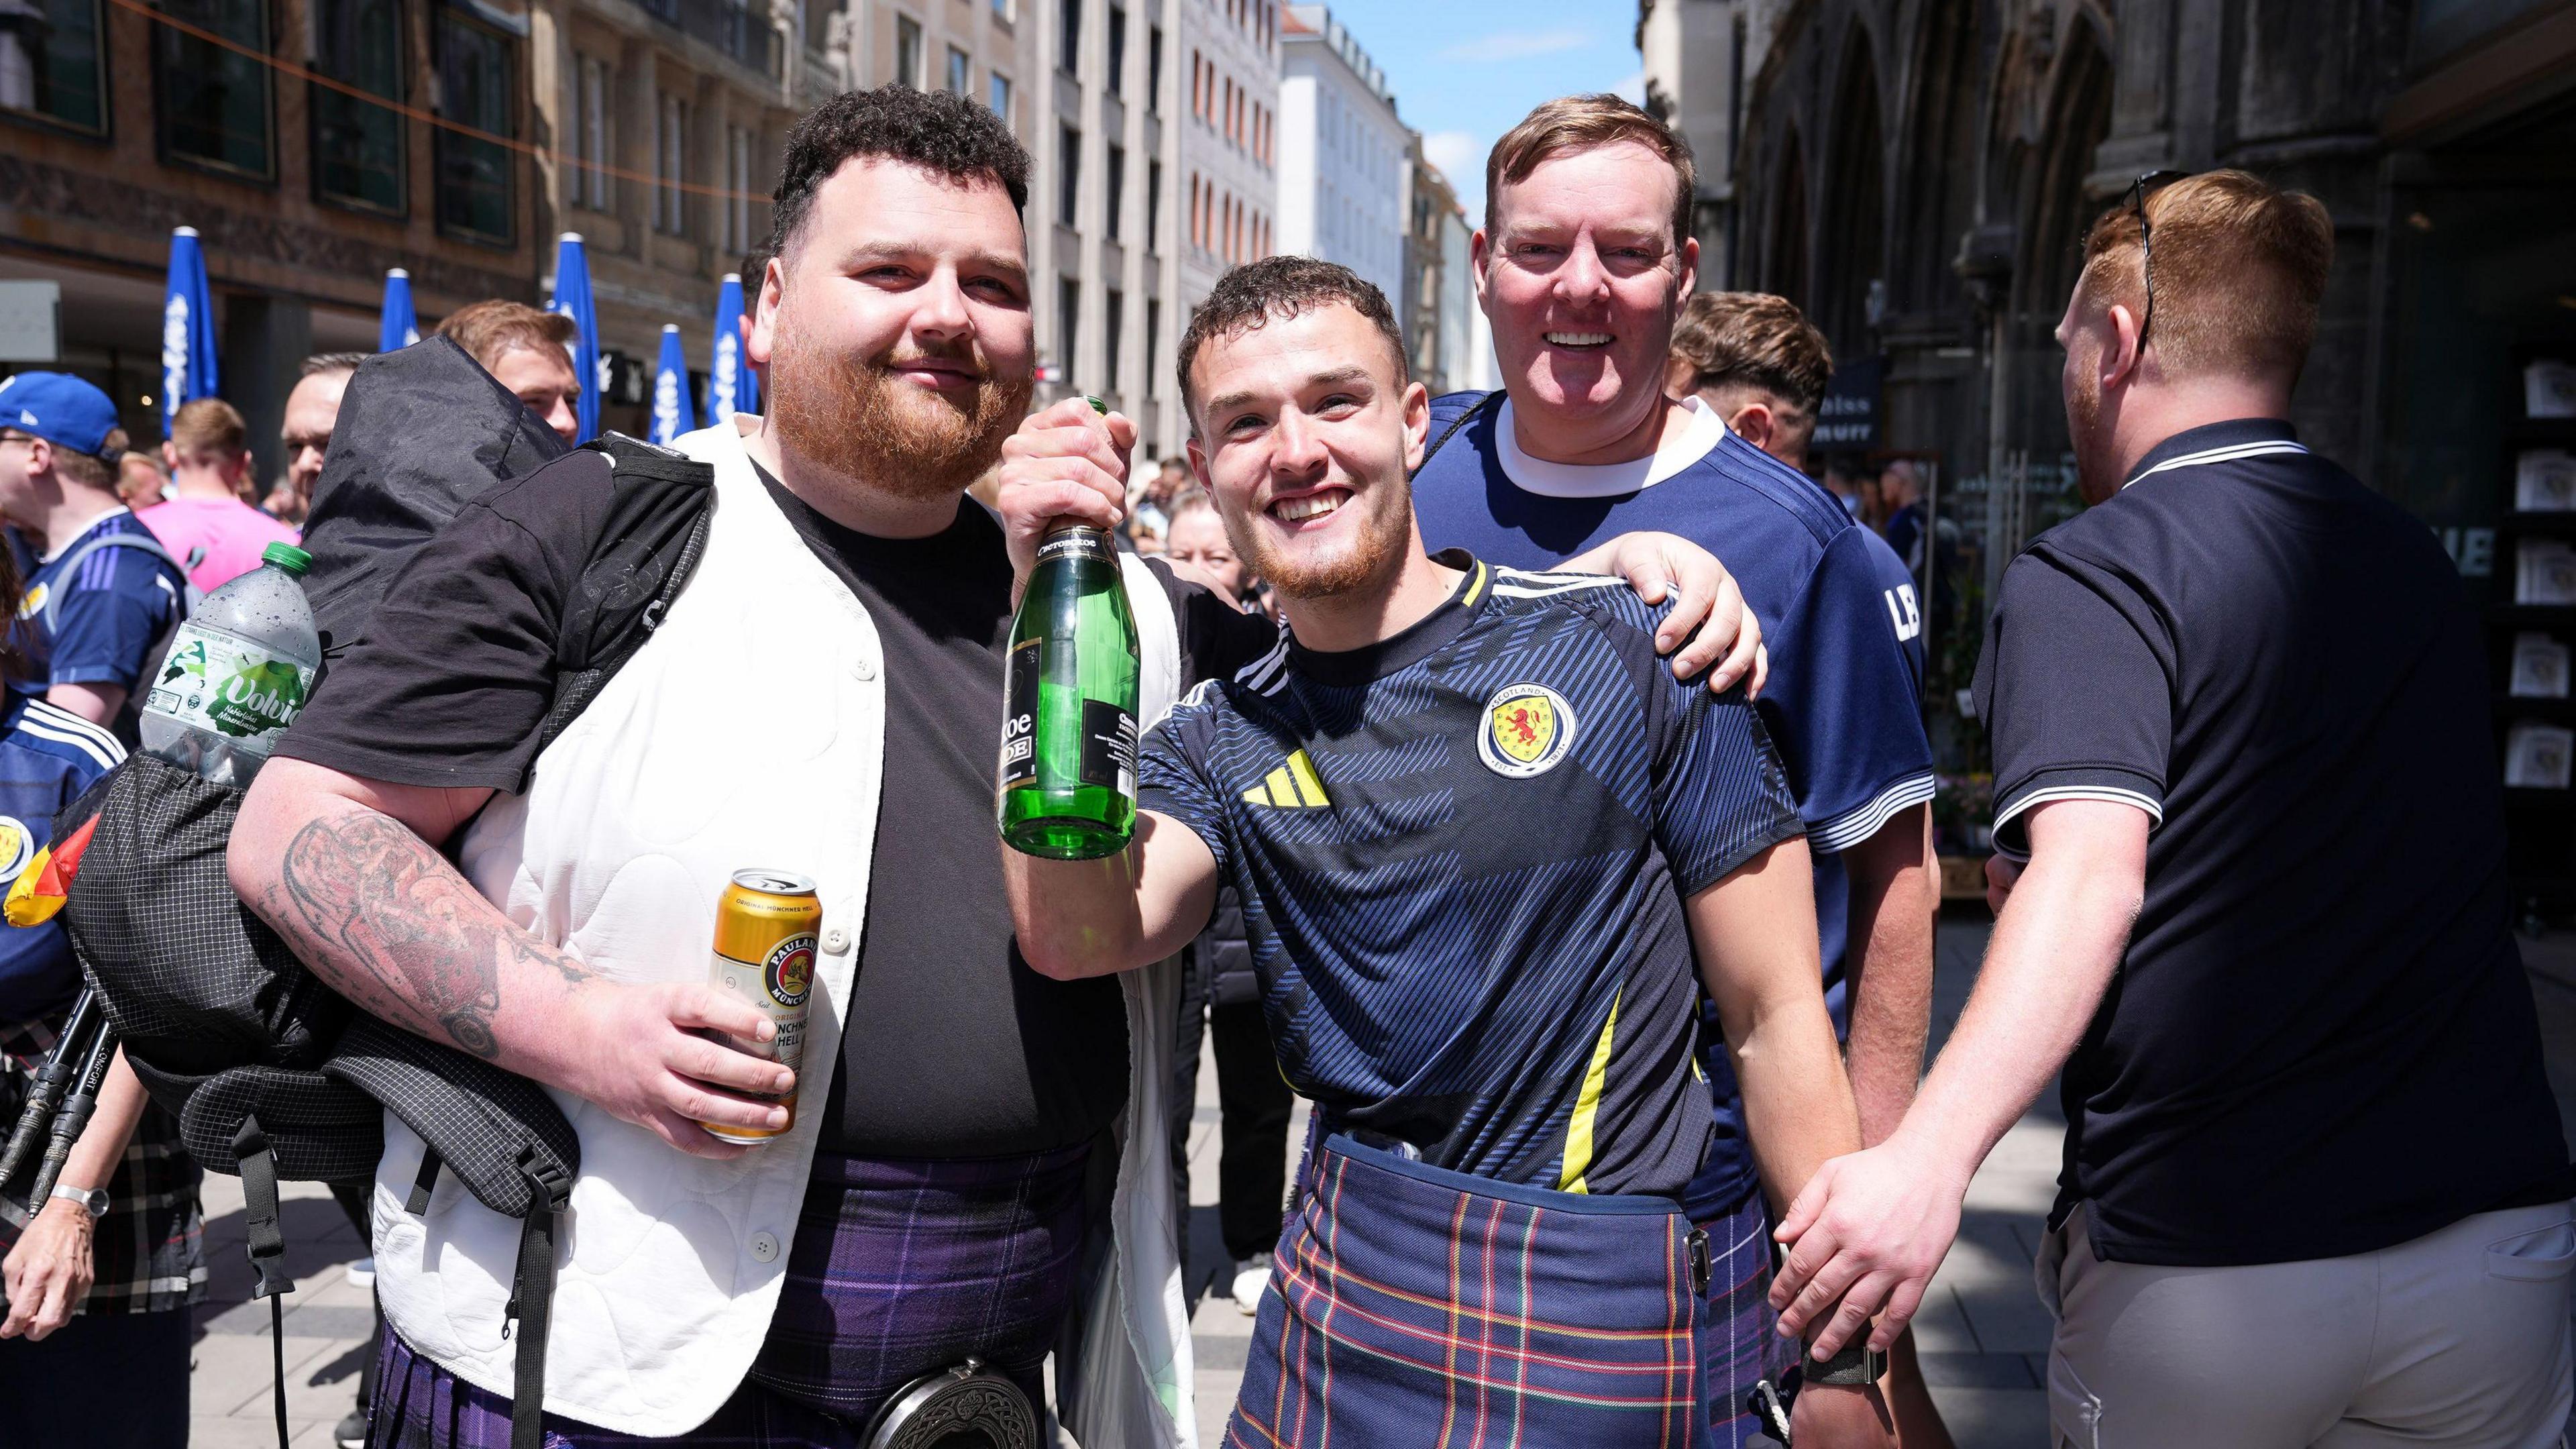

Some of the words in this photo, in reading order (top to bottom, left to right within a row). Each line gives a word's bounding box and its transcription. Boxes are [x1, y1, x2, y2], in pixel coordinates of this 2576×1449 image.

[1493, 688, 1541, 704] SCOTLAND
[1550, 747, 1565, 762] 1873
[1494, 762, 1507, 771] EST
[770, 938, 817, 965] PAULANE
[777, 1034, 799, 1047] HELL
